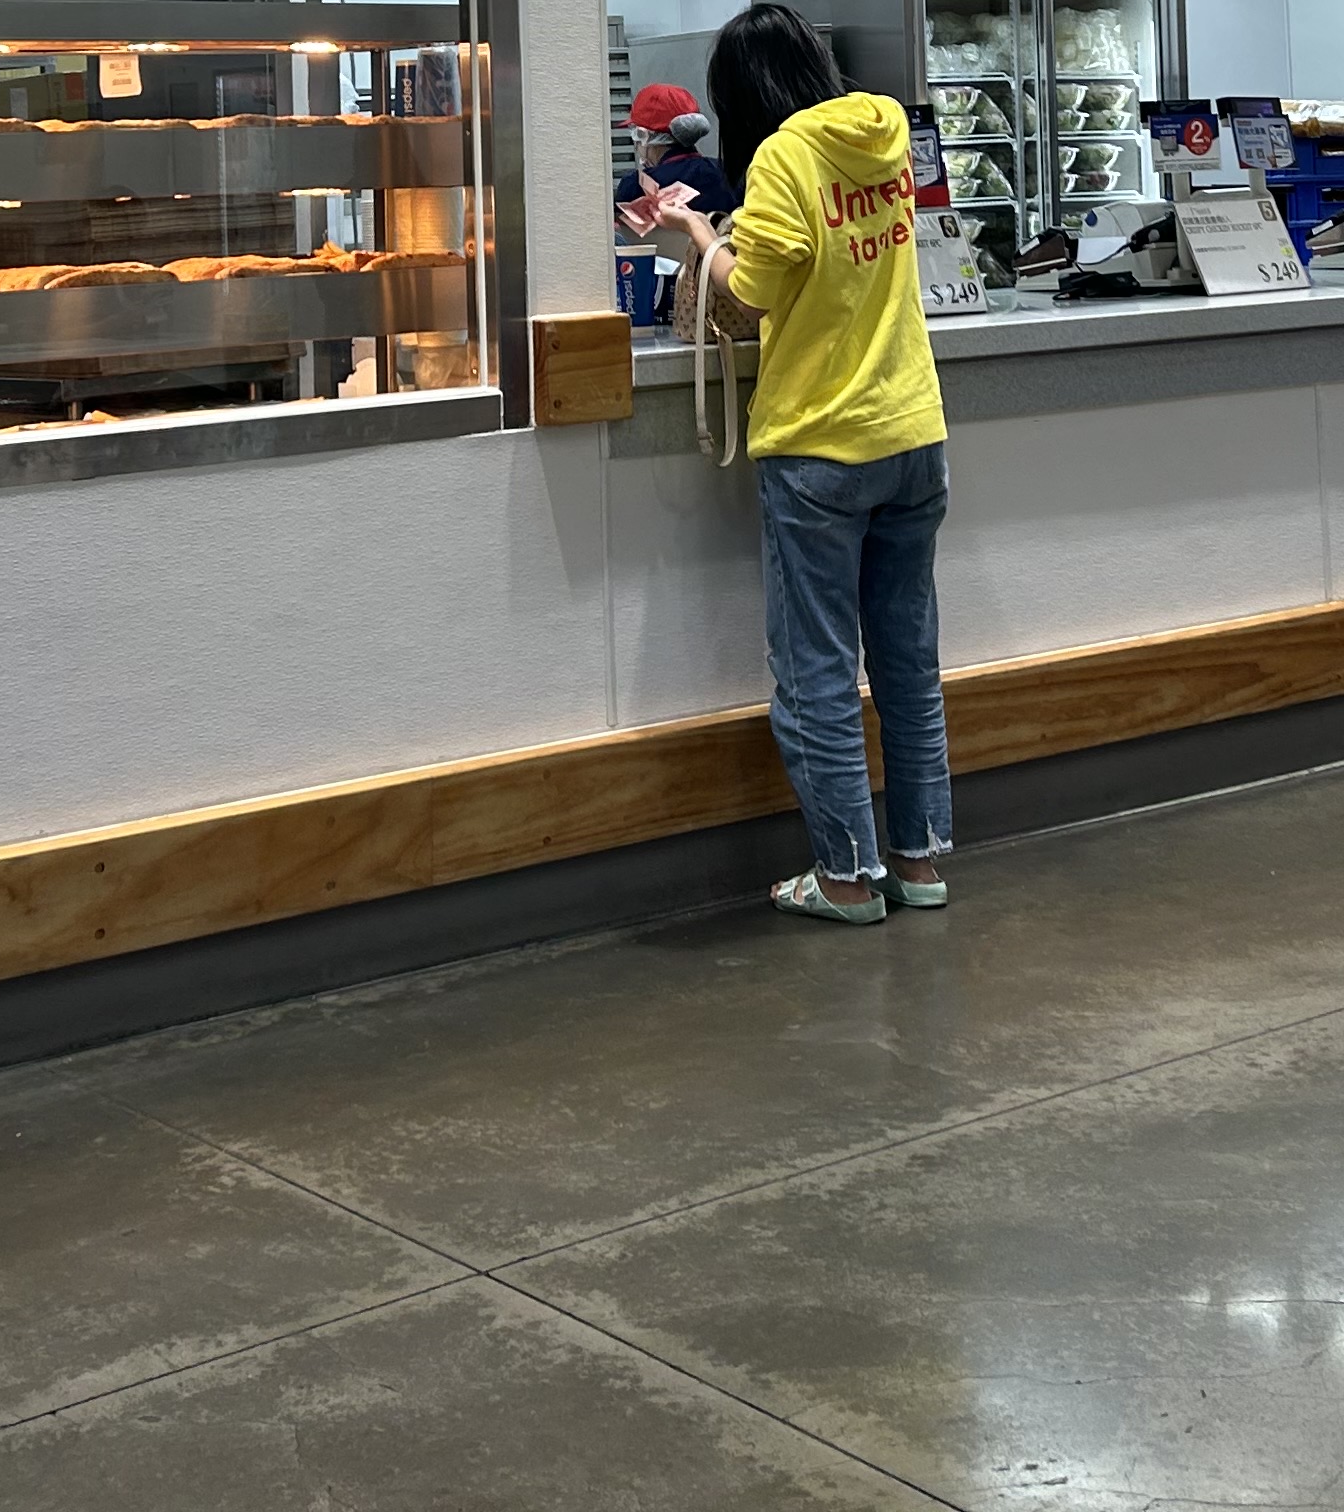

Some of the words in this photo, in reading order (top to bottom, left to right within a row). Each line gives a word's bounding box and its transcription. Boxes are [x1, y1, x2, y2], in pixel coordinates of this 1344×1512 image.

[1271, 261, 1299, 280] 249
[623, 279, 636, 315] pepsi
[946, 281, 979, 304] 249
